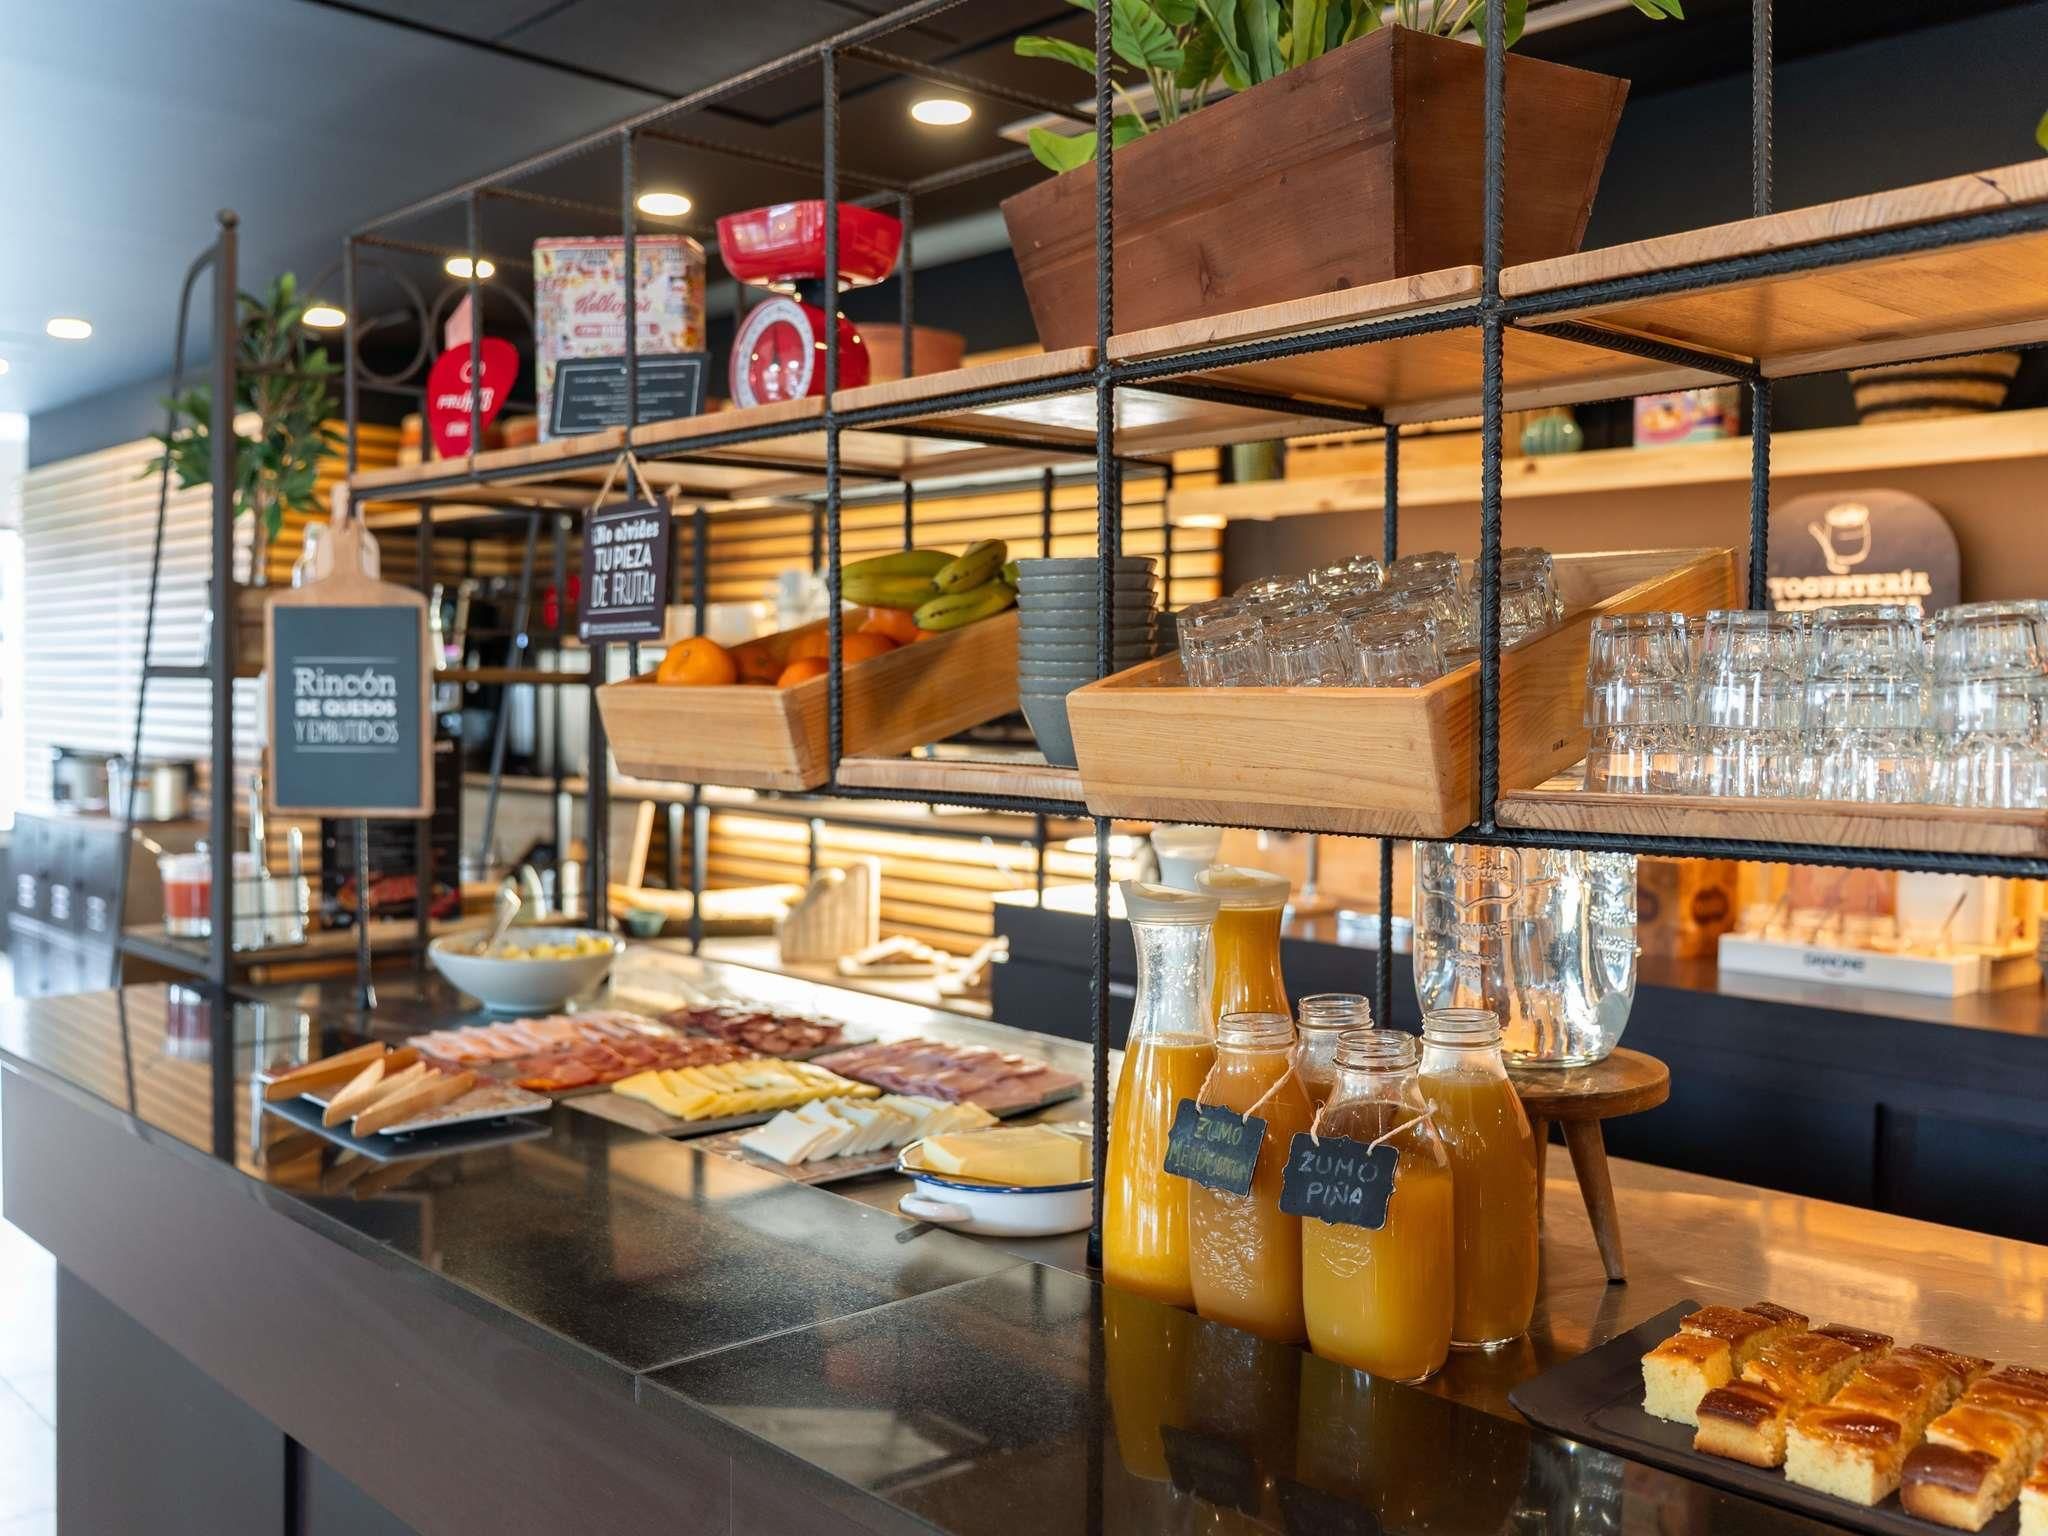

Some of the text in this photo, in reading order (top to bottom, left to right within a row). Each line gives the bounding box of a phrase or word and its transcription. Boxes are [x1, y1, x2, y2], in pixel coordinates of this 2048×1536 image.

[614, 519, 659, 542] olvides
[594, 543, 652, 572] TU PIEZA
[591, 571, 656, 607] DE FRUTA!
[293, 666, 397, 697] Rincón
[295, 700, 396, 716] DE QUESOS
[294, 720, 399, 744] Y EMBUTIDOS
[1194, 1117, 1243, 1146] ZUMO
[1298, 1151, 1378, 1183] ZUMO
[1306, 1180, 1363, 1206] PIÑA
